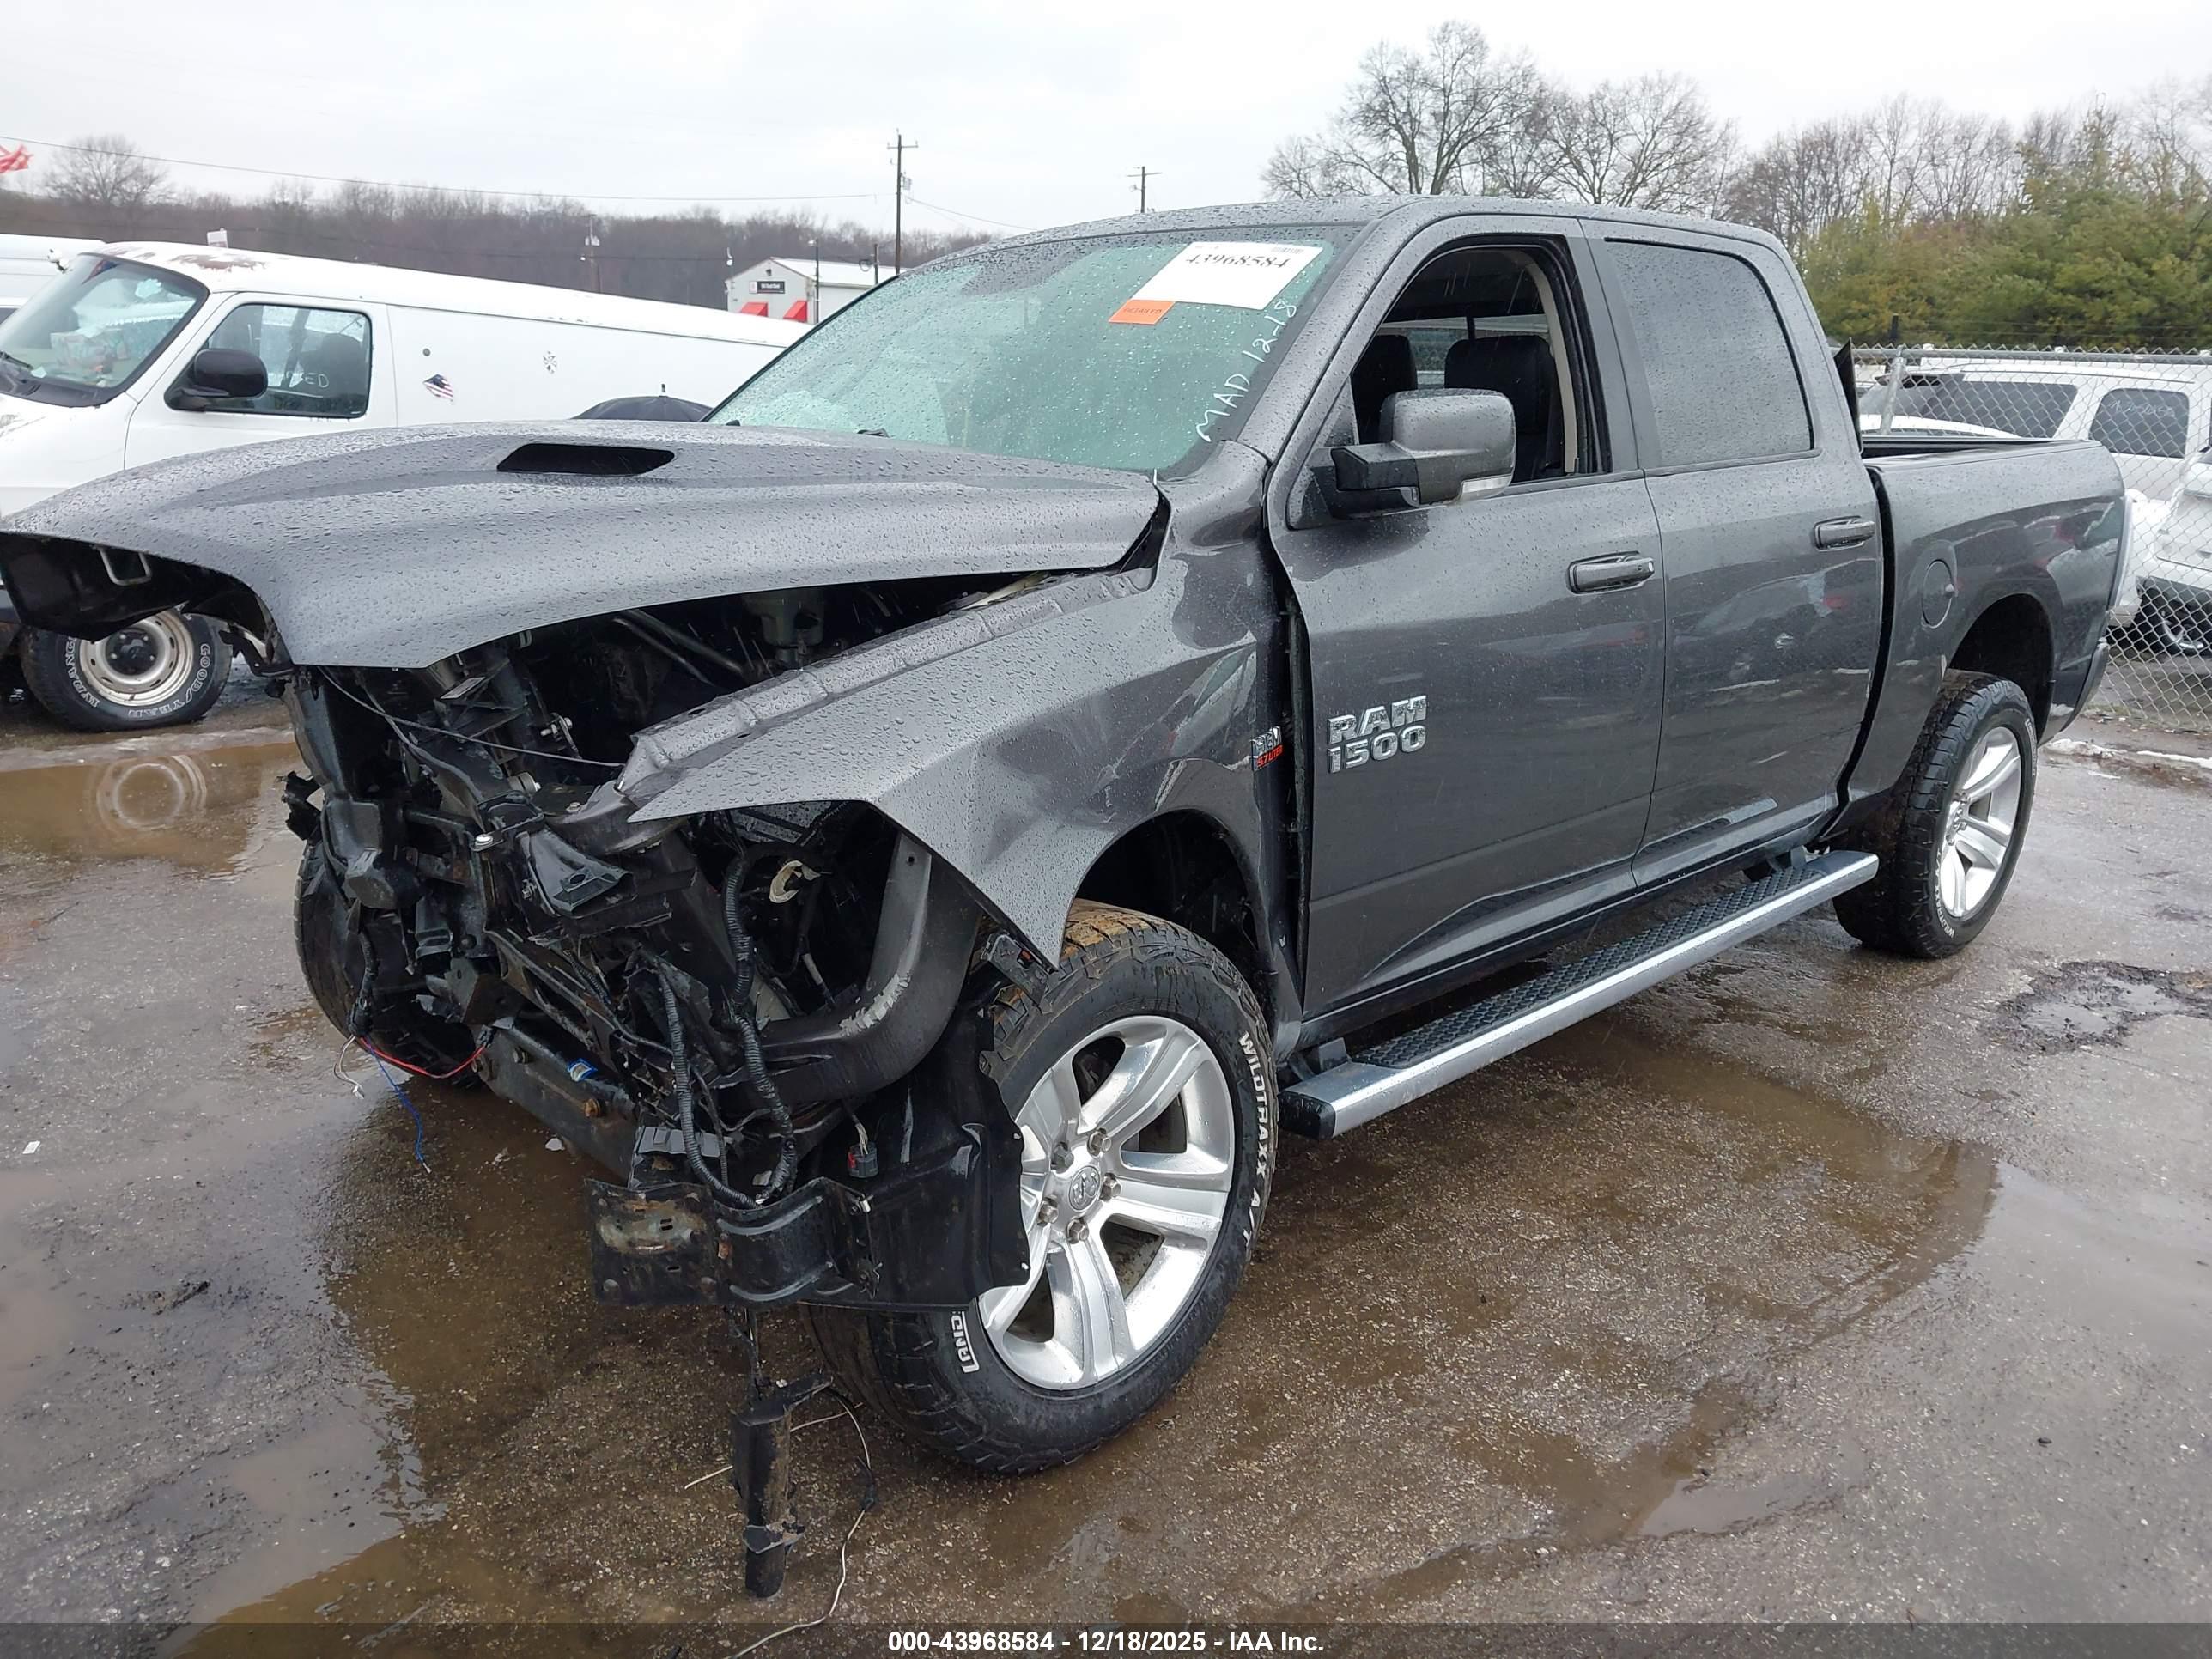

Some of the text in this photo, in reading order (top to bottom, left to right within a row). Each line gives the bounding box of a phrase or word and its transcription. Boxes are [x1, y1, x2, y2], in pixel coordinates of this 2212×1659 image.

[1186, 254, 1291, 268] 43968584
[1196, 301, 1297, 442] MAD 12-18
[65, 635, 100, 708] WRANG
[1328, 694, 1427, 744] RAM
[1328, 725, 1426, 774] 1500
[1239, 1031, 1269, 1180] WILDTRAXX
[951, 1310, 980, 1373] LAND
